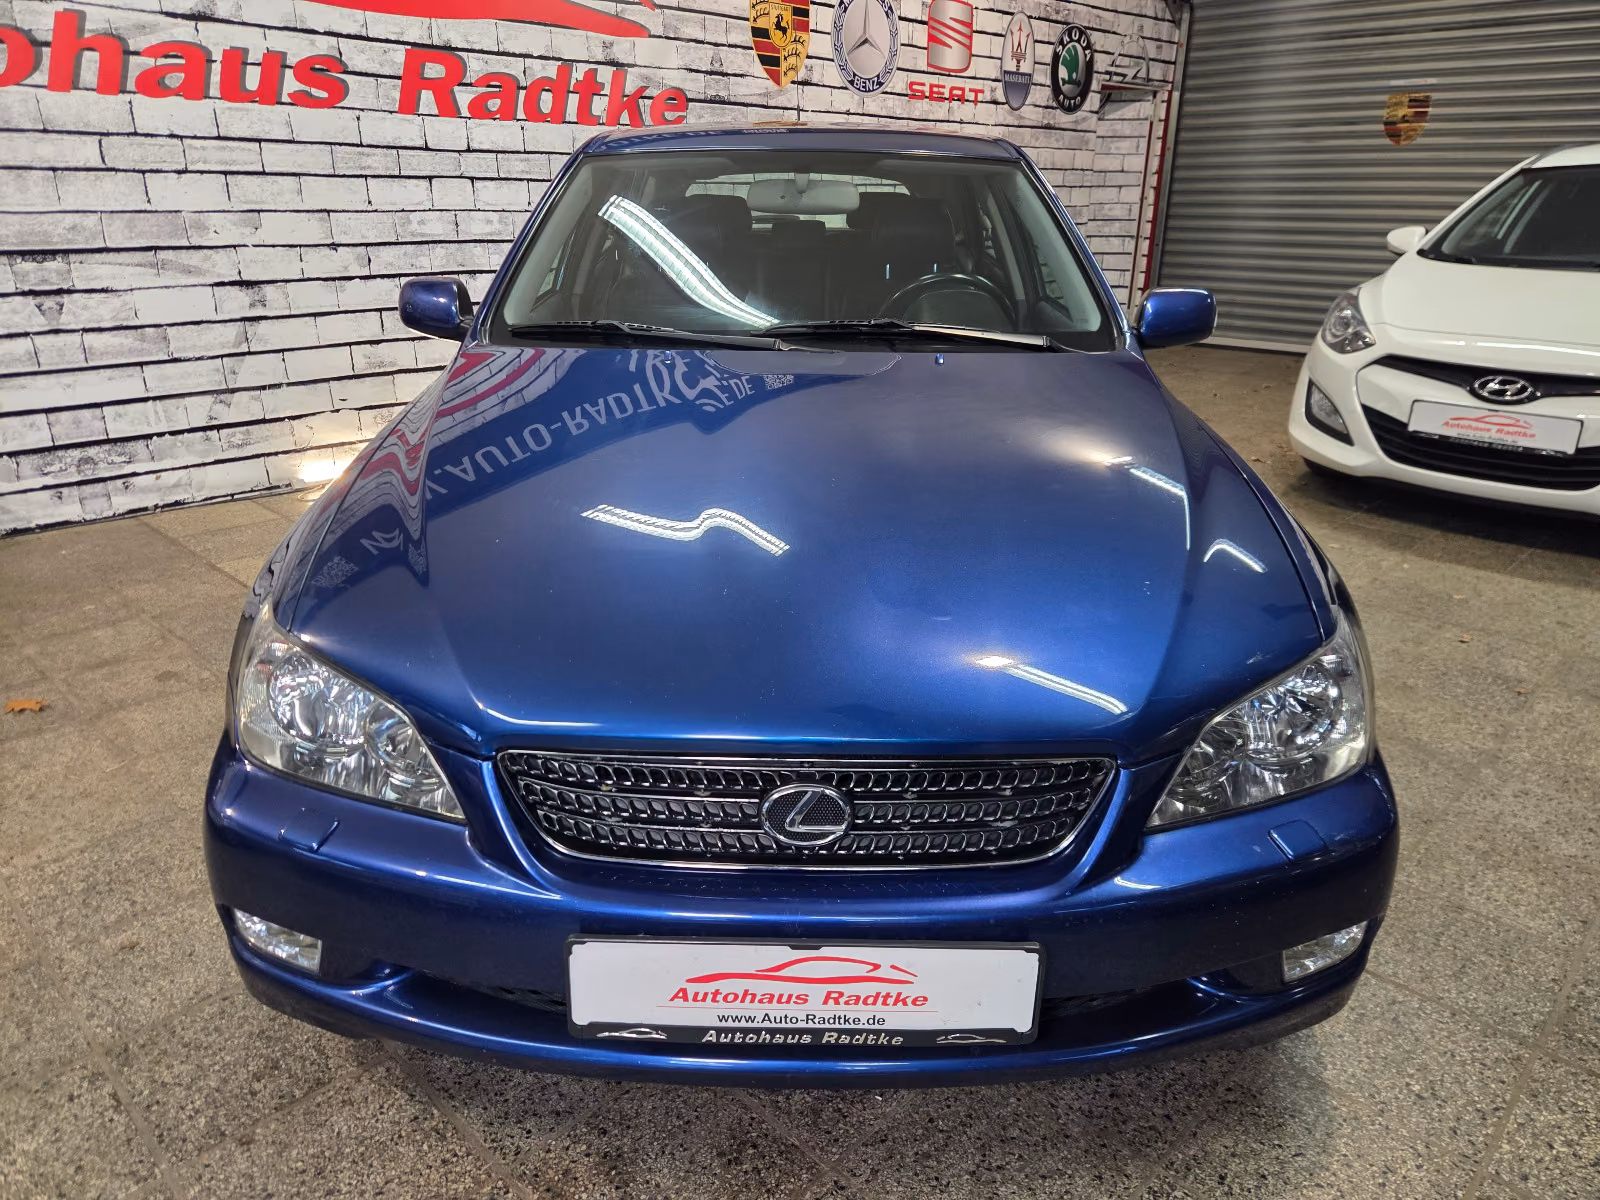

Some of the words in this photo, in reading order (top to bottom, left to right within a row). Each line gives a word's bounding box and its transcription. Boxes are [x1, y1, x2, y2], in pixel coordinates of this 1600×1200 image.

[853, 78, 880, 91] BENZ
[1004, 73, 1031, 84] MASERATI
[397, 48, 687, 128] Radtke
[907, 81, 985, 107] SEAT
[1059, 94, 1081, 108] AUTO
[669, 987, 809, 1006] Autohaus
[822, 990, 929, 1008] Radtke
[717, 1012, 886, 1027] www.Auto-Radtke.de
[702, 1030, 812, 1045] Autohaus
[822, 1031, 904, 1046] Radtke
